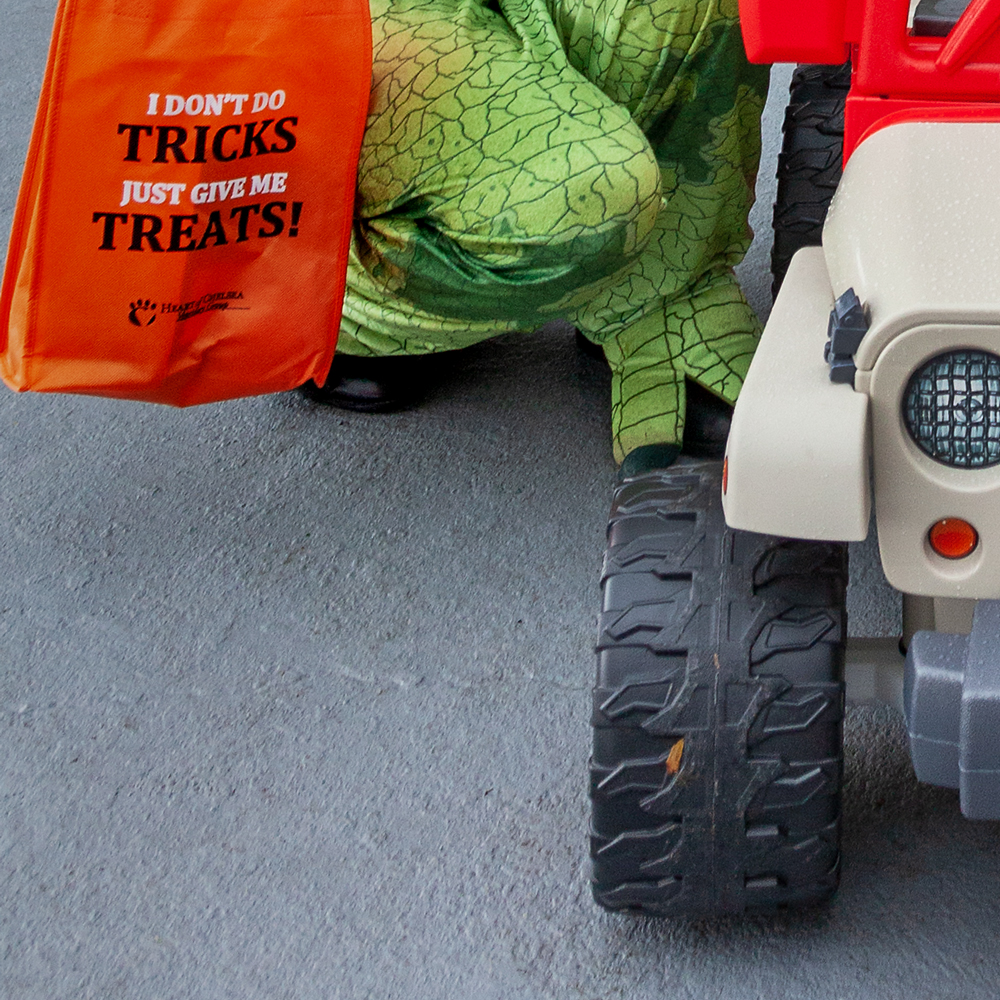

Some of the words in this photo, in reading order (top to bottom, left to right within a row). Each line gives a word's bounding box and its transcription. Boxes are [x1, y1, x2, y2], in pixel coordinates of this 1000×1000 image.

[147, 93, 160, 116] I
[163, 93, 249, 116] DON'T
[251, 89, 286, 113] DO
[117, 116, 299, 164] TRICKS
[119, 179, 187, 207] JUST
[190, 177, 247, 204] GIVE
[249, 172, 289, 196] ME
[92, 201, 304, 253] TREATS!
